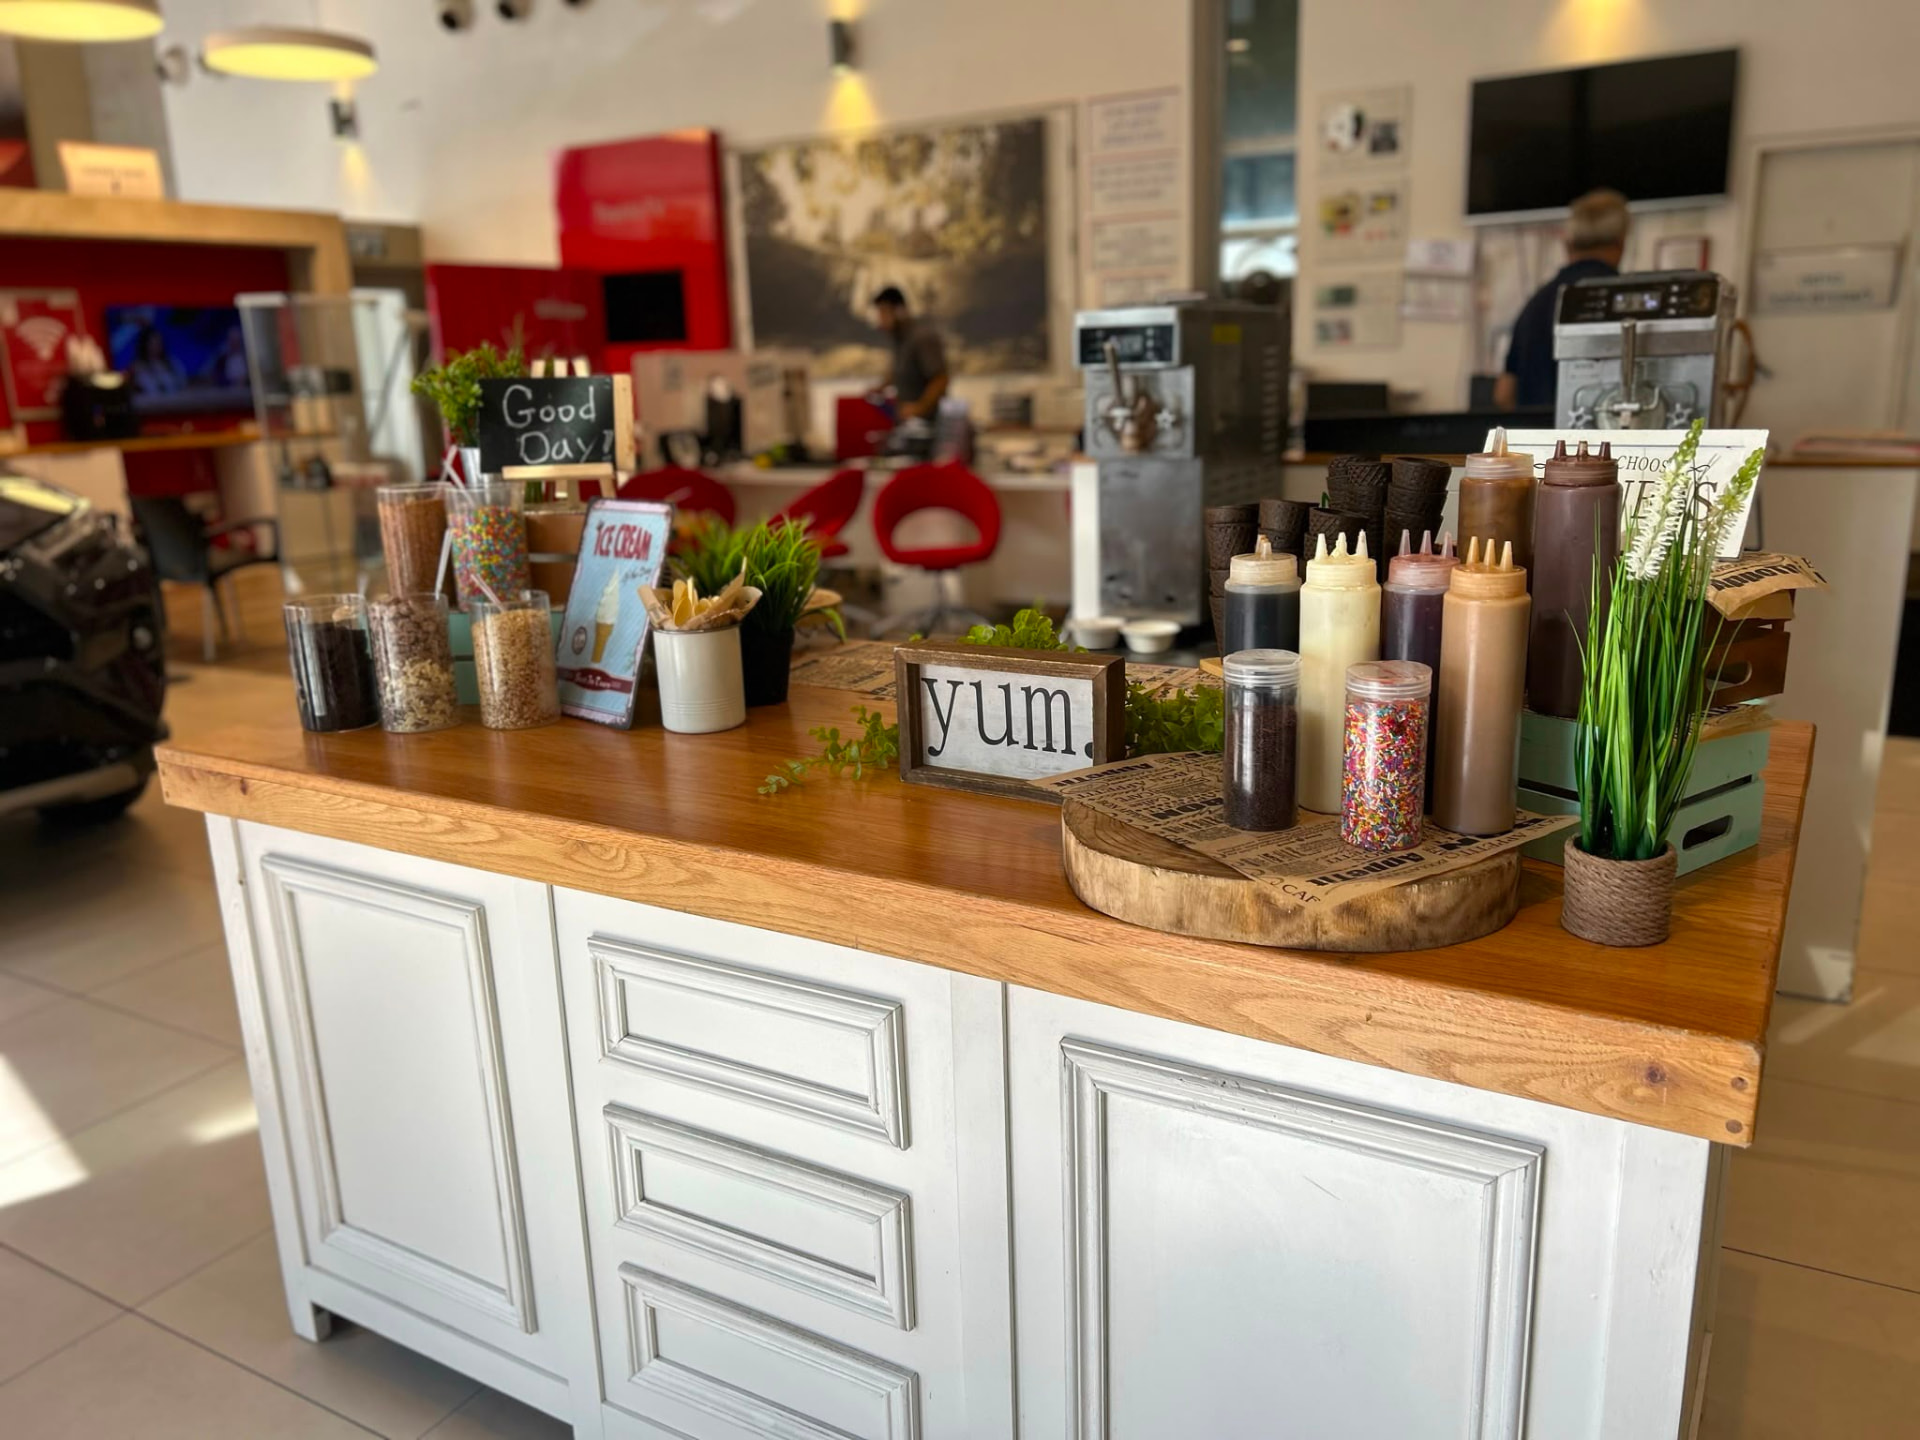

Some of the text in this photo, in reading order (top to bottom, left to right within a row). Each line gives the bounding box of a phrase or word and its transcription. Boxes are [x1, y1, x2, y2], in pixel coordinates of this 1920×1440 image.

[503, 384, 596, 428] Good
[594, 521, 653, 561] ICE CREAM
[921, 677, 1094, 758] yum.
